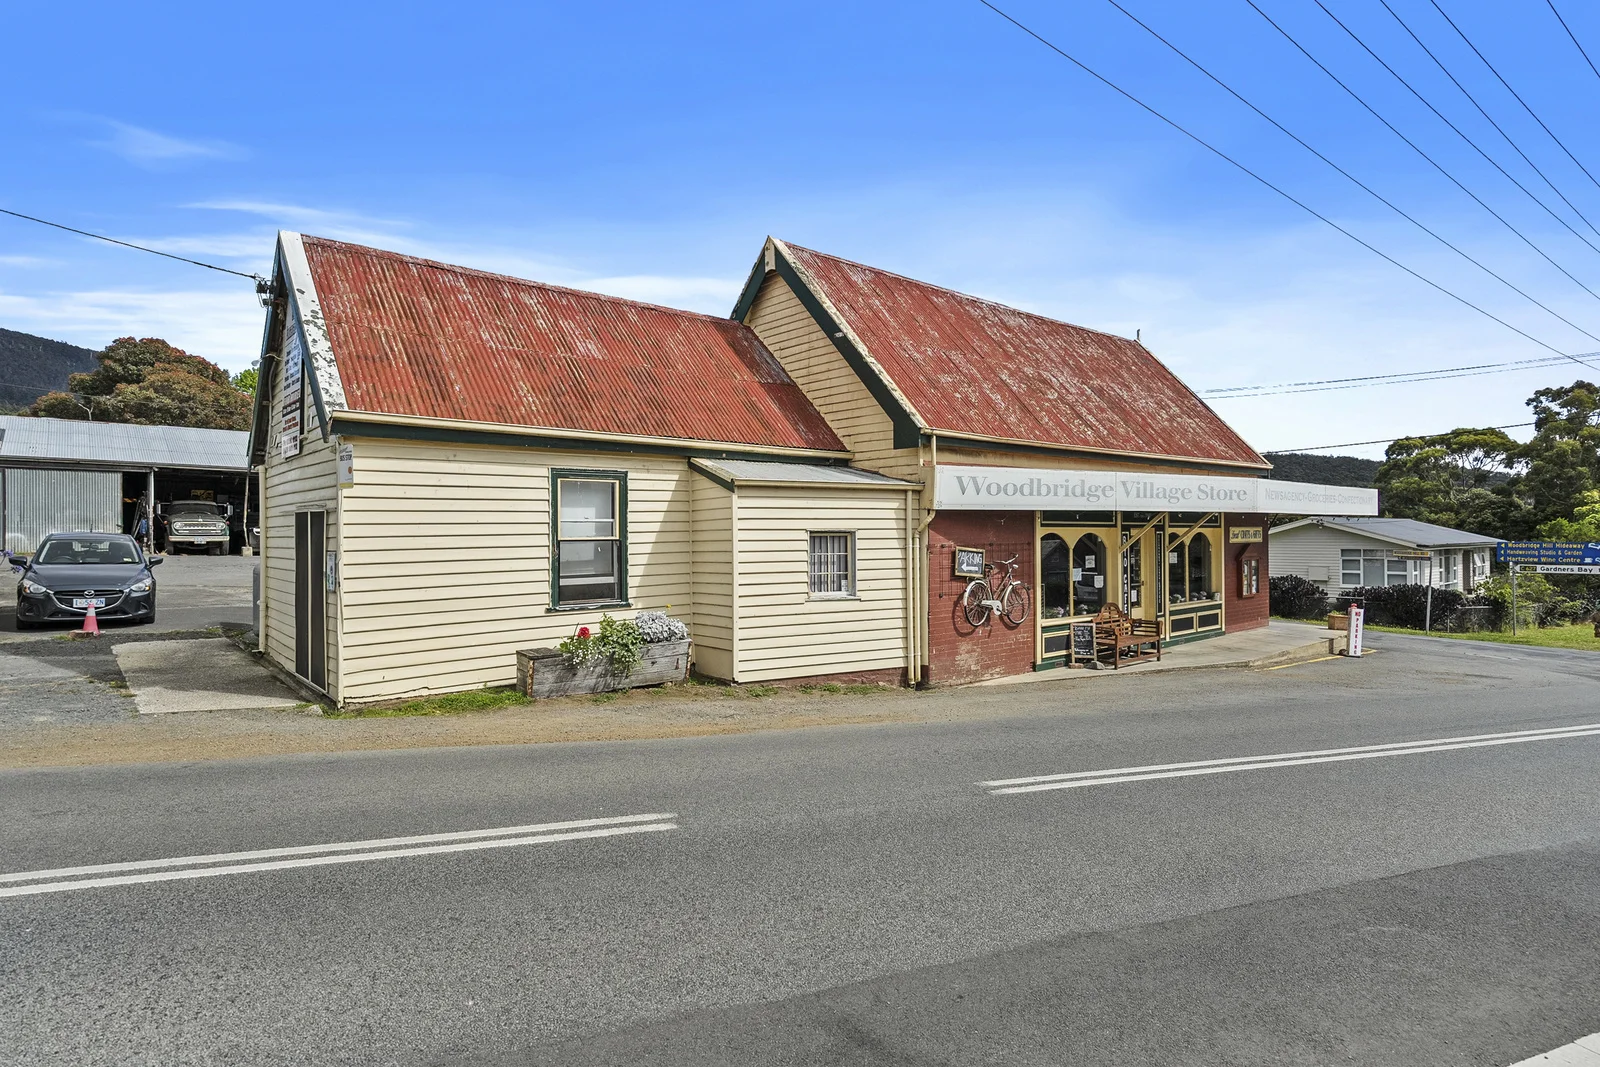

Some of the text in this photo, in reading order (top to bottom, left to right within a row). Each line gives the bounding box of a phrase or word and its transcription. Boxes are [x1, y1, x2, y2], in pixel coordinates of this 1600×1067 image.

[953, 475, 1248, 504] Woodbridge Village Store
